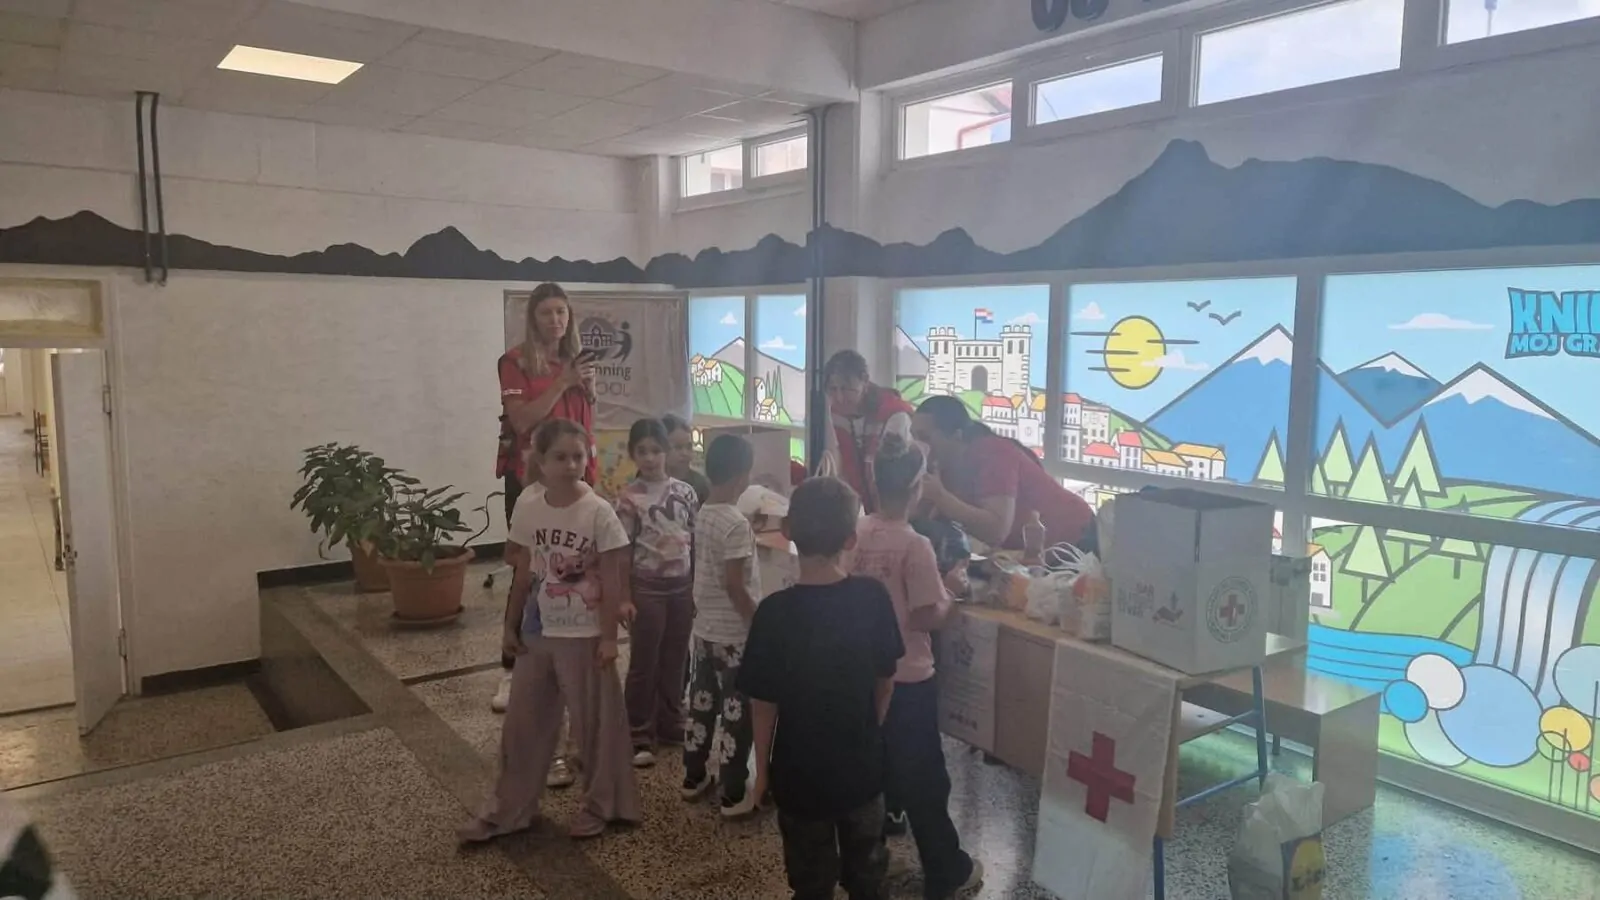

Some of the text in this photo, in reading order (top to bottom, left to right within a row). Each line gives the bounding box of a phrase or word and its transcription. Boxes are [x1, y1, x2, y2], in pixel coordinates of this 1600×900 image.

[1508, 333, 1559, 355] MOJ
[594, 363, 632, 381] nning
[595, 381, 631, 397] OOL
[532, 528, 599, 553] NGEL
